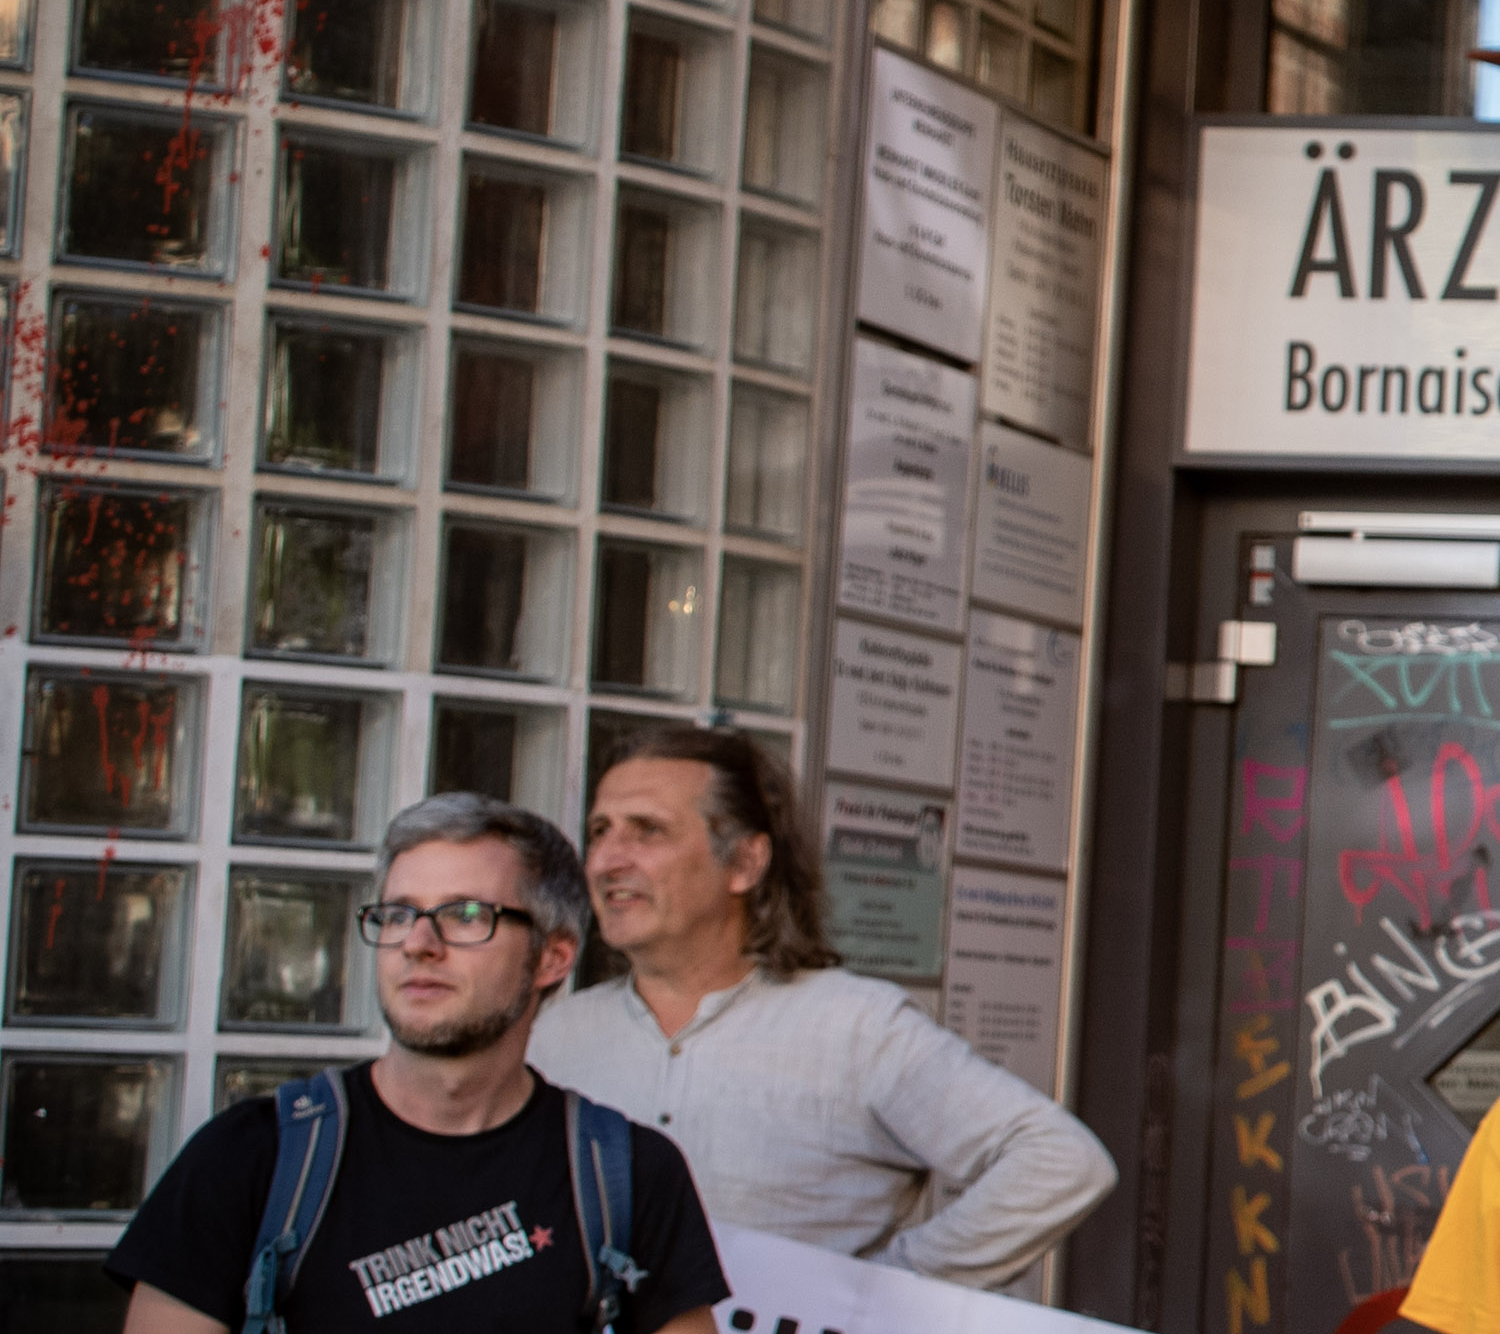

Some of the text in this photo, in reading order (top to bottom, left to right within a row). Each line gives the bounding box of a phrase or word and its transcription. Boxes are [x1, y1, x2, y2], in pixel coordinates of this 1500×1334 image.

[348, 1200, 523, 1291] TRINK NICHT
[364, 1231, 534, 1318] IRGENDWAS!
